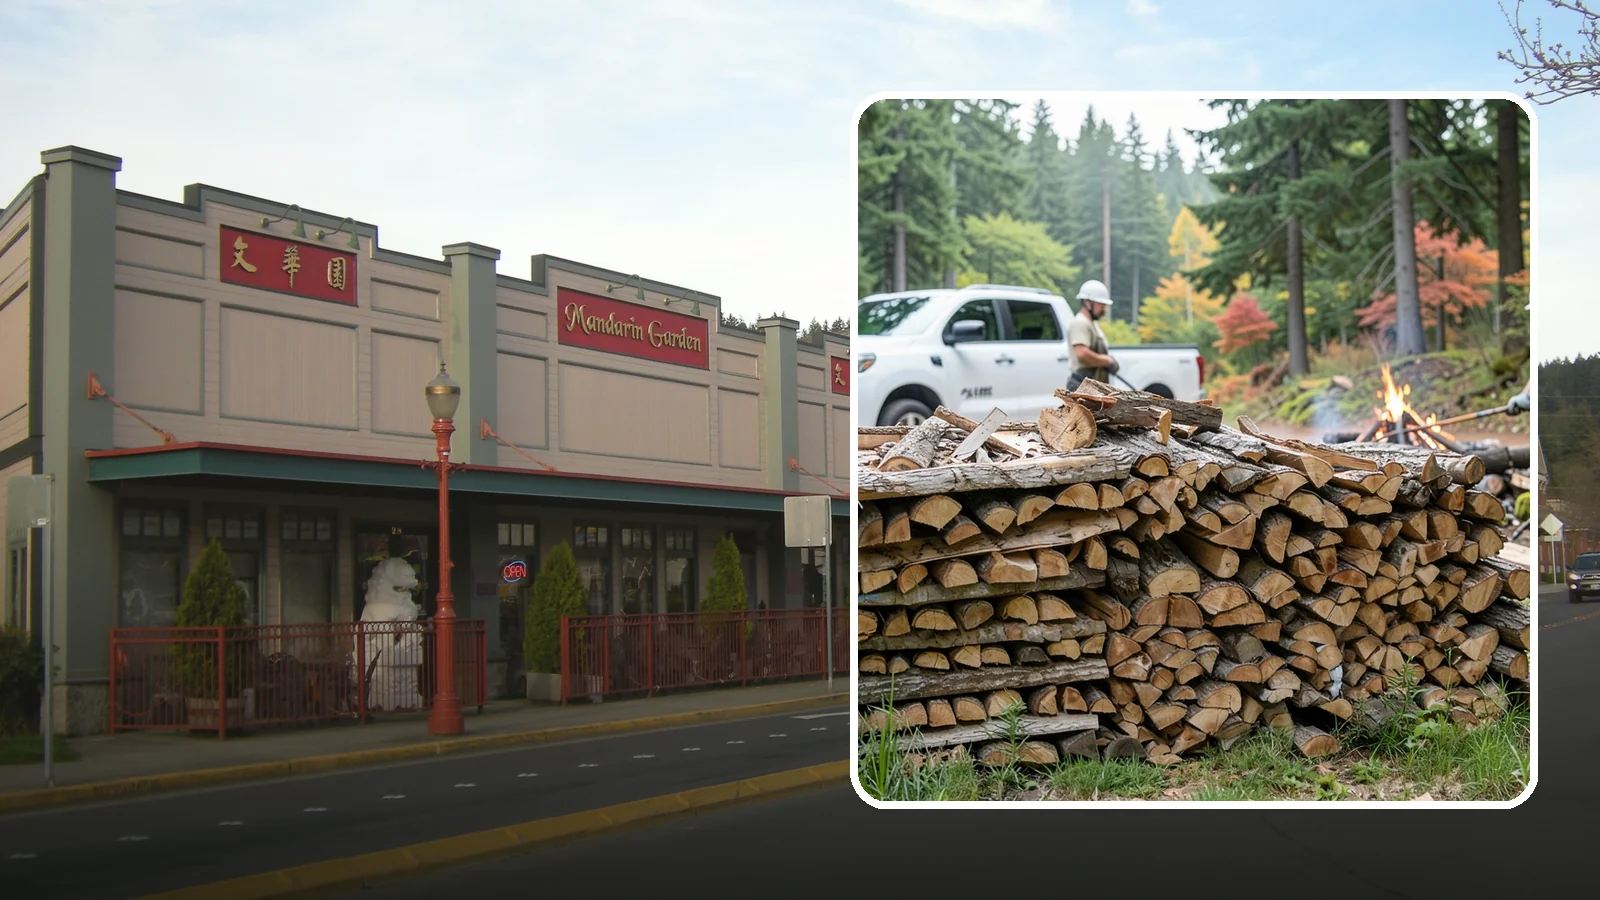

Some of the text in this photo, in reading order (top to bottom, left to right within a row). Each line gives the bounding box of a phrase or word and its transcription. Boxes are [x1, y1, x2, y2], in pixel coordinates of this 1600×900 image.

[230, 235, 347, 291] 文華園
[564, 302, 702, 352] Mandarin Garden
[503, 565, 527, 578] OPEN
